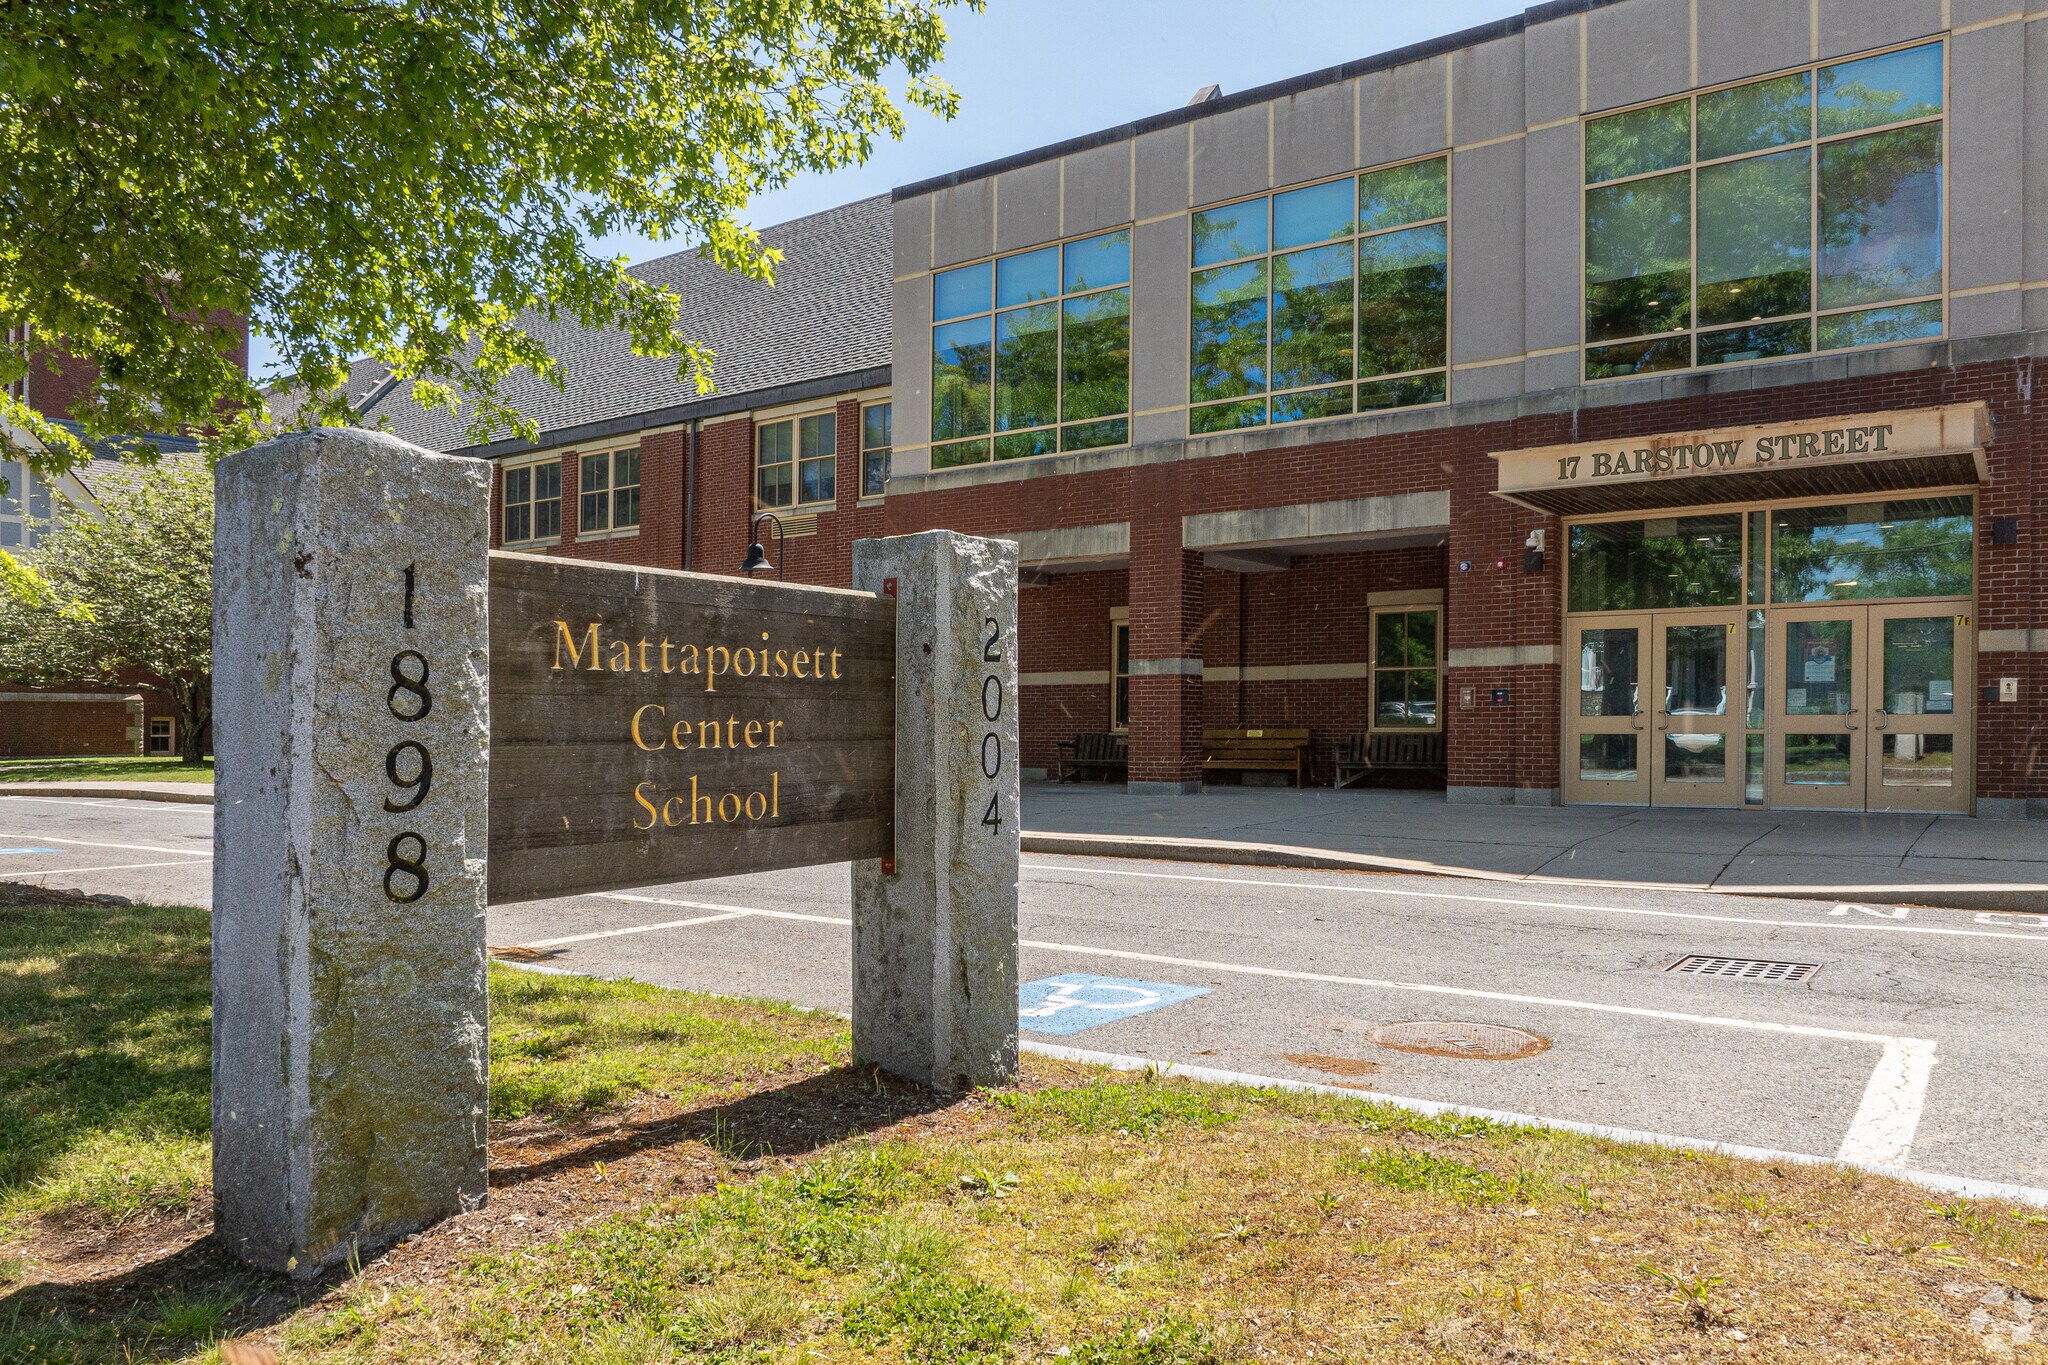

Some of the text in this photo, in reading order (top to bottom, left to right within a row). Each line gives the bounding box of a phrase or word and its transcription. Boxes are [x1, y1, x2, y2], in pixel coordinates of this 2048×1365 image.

[1558, 425, 1892, 480] 17 BARSTOW STREET
[550, 620, 843, 692] Mattapoisett
[1728, 623, 1736, 634] 7
[383, 560, 432, 903] 1898
[631, 704, 783, 752] Center
[982, 617, 1003, 835] 2004
[633, 771, 780, 830] School
